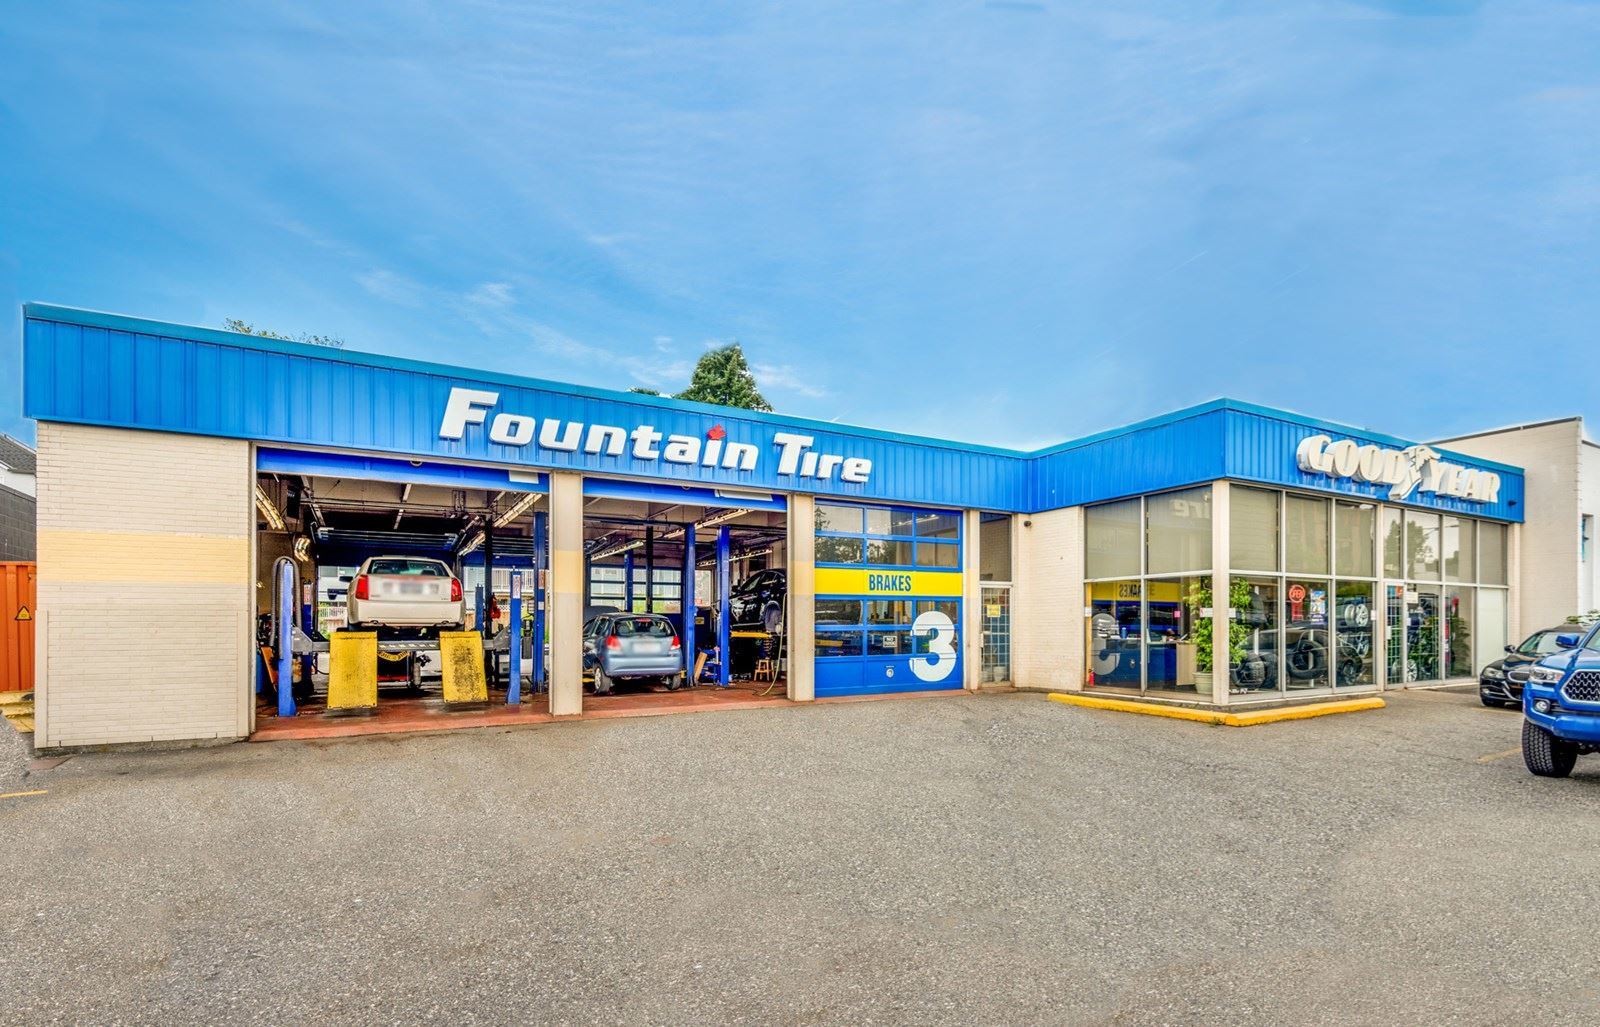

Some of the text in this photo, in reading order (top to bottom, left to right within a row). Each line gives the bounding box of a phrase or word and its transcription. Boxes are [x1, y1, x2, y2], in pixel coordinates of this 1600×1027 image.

[439, 386, 872, 483] Fountain Tire
[868, 573, 912, 592] BRAKES
[909, 610, 957, 682] 3
